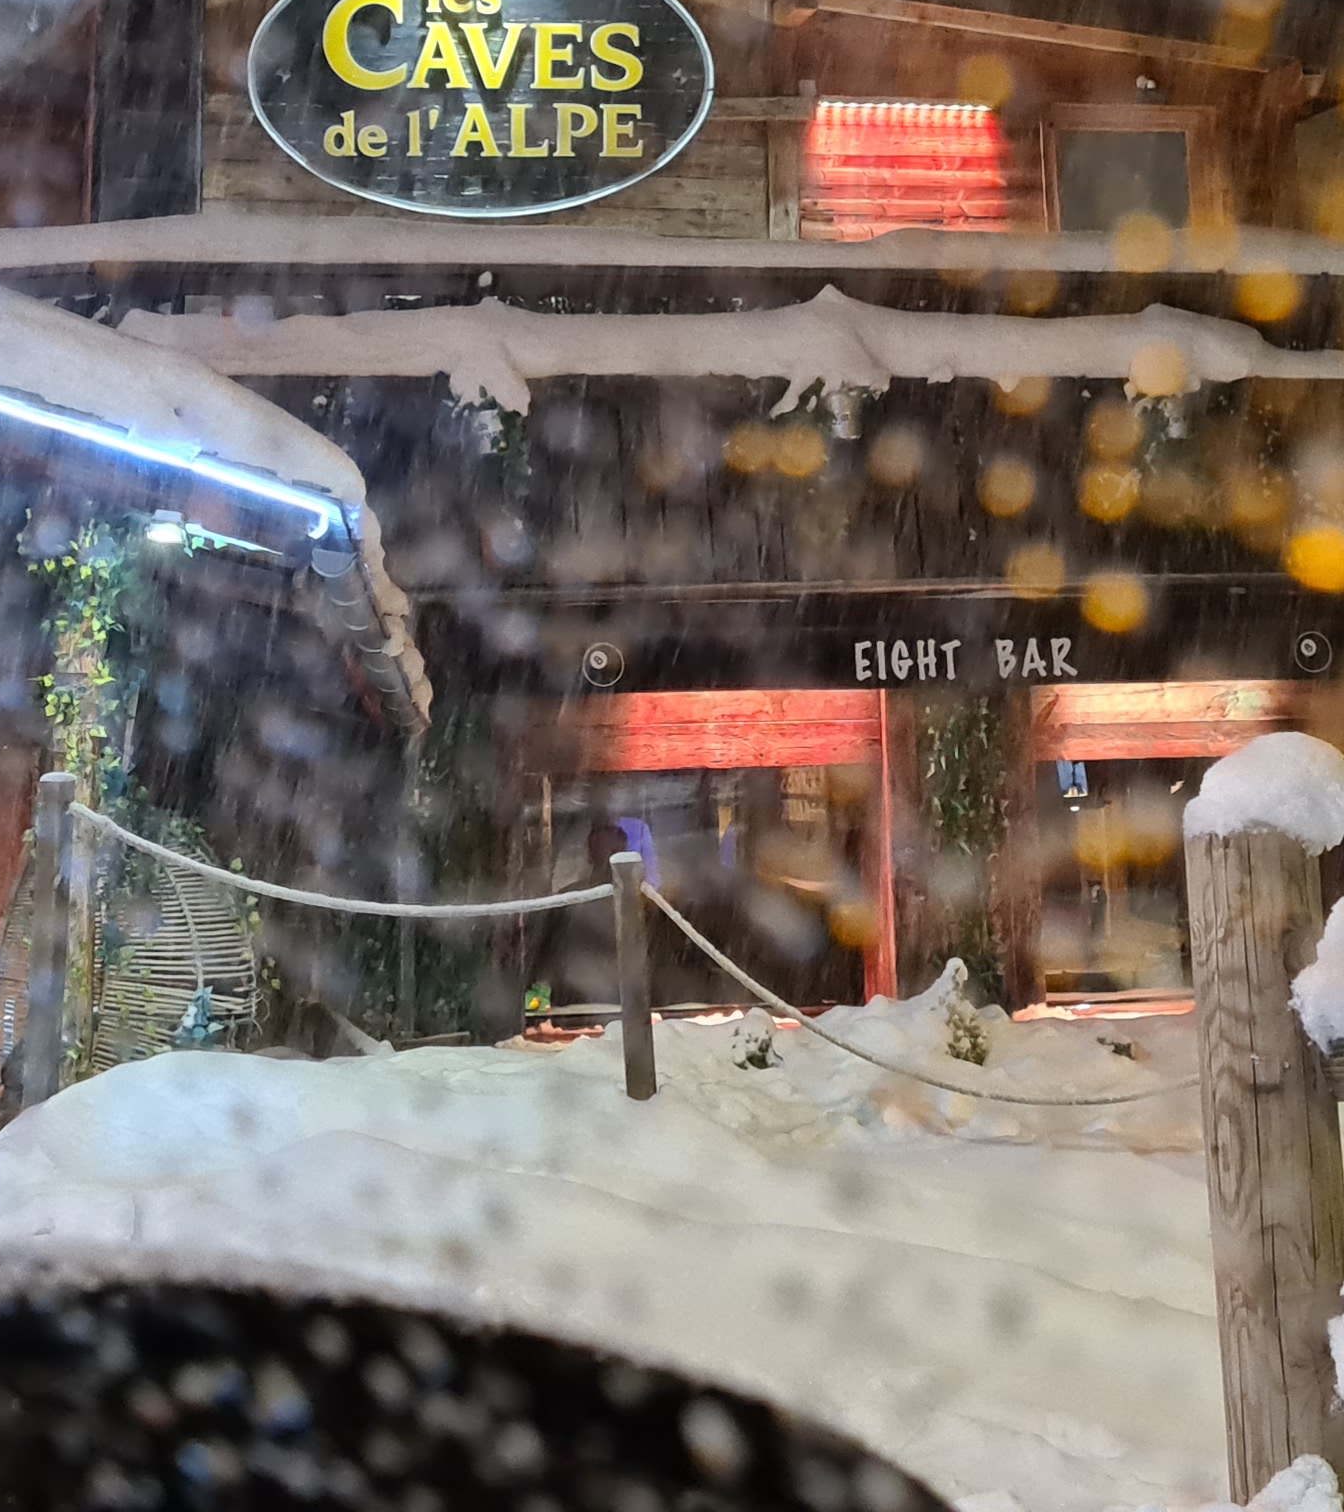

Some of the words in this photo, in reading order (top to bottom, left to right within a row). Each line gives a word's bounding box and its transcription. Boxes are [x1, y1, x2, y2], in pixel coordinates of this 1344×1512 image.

[323, 109, 388, 157] de
[854, 639, 962, 682] EIGHT
[995, 637, 1079, 680] BAR
